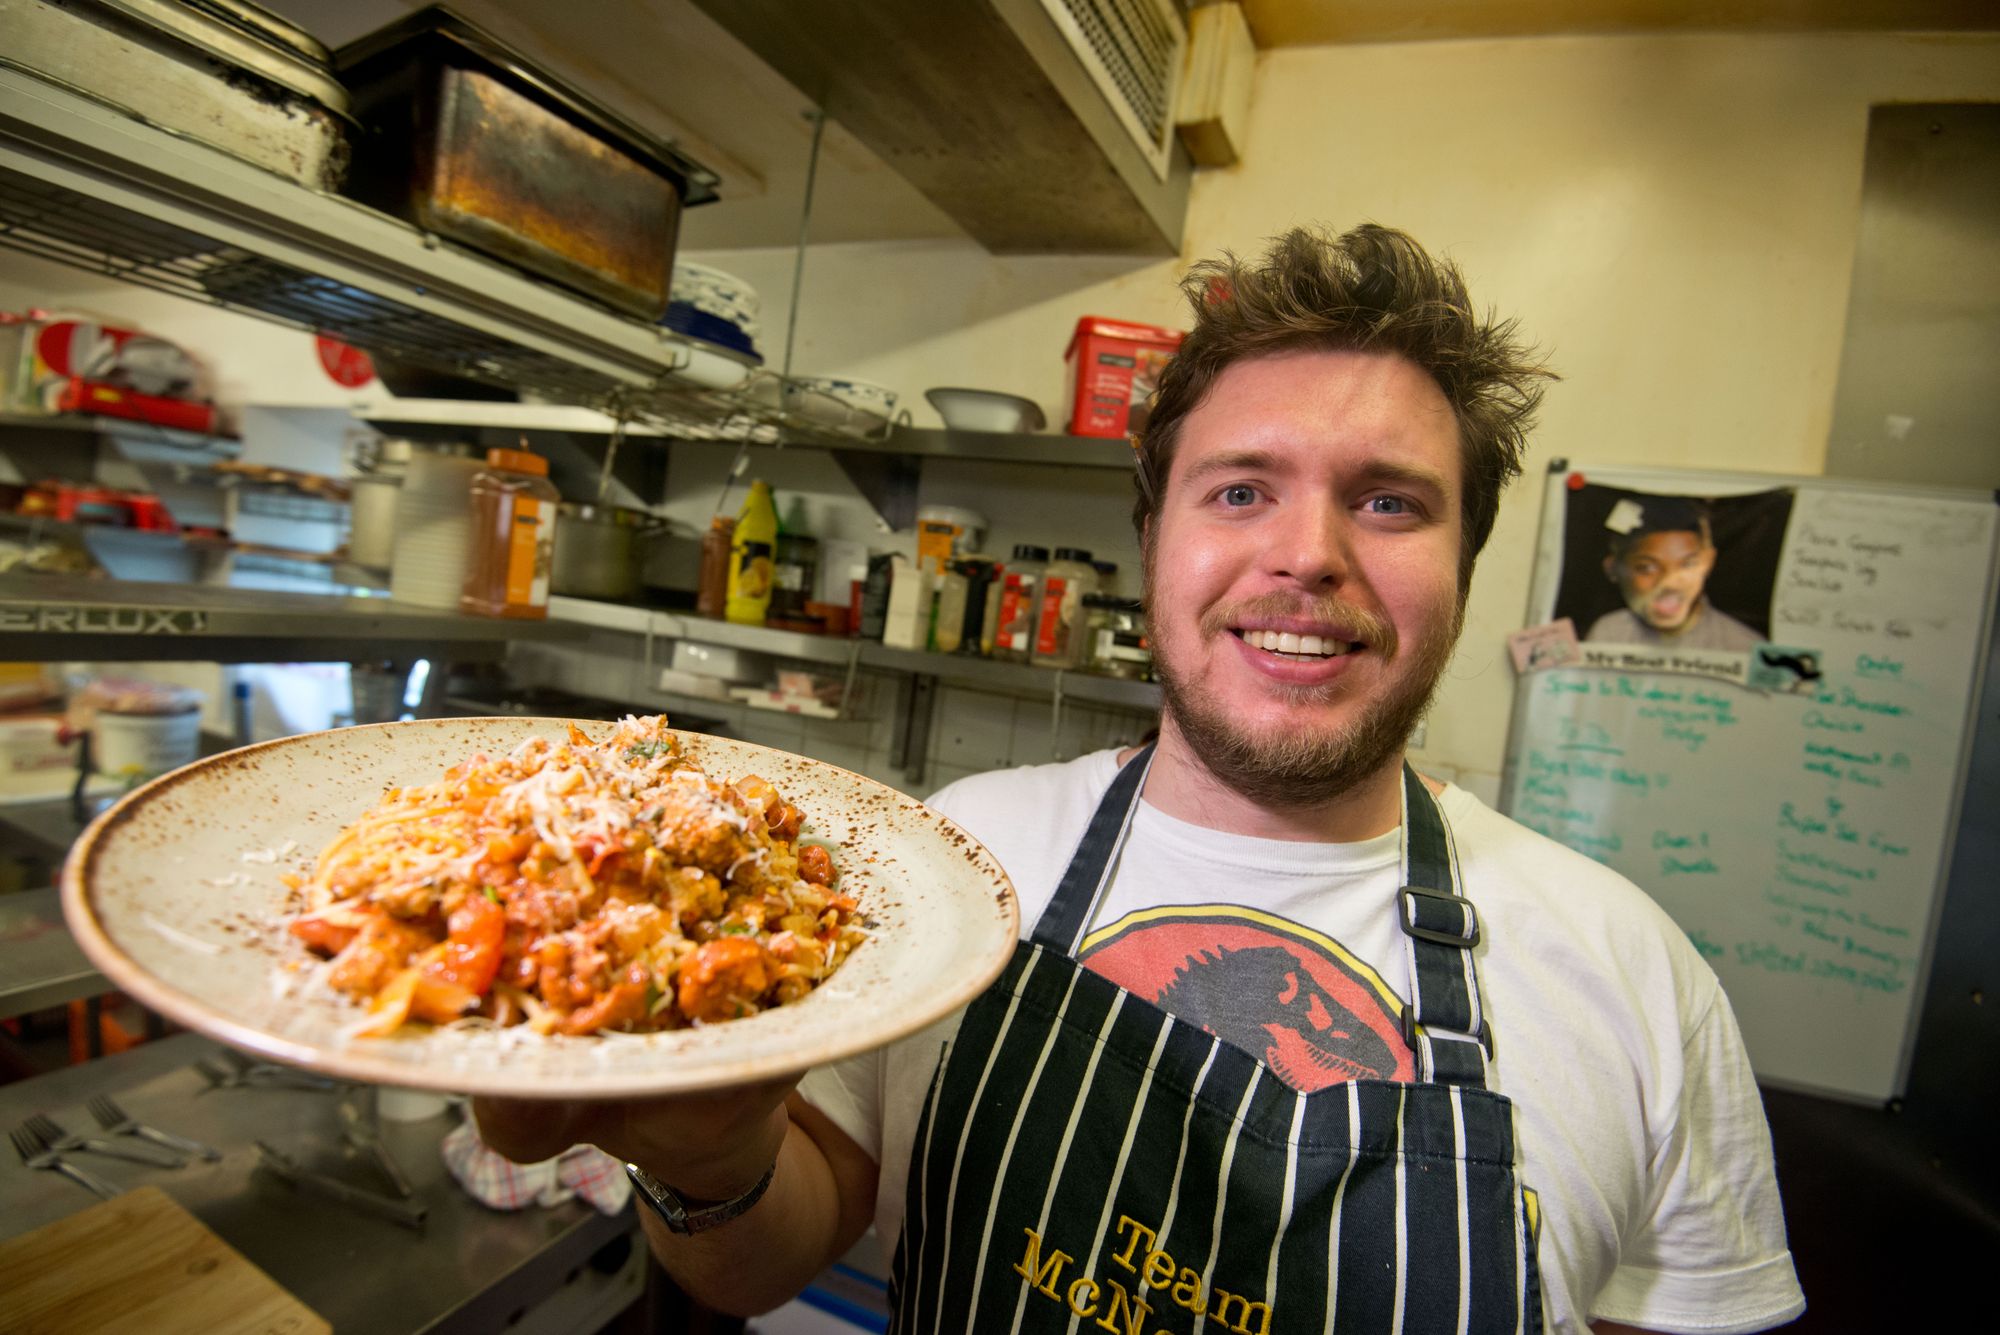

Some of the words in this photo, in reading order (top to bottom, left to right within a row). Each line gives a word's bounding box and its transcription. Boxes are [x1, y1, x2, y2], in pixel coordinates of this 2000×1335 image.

[1585, 652, 1614, 665] My
[1621, 652, 1665, 669] Best
[1671, 655, 1743, 677] Friend
[1012, 1226, 1175, 1335] McN
[1112, 1214, 1273, 1335] Team
